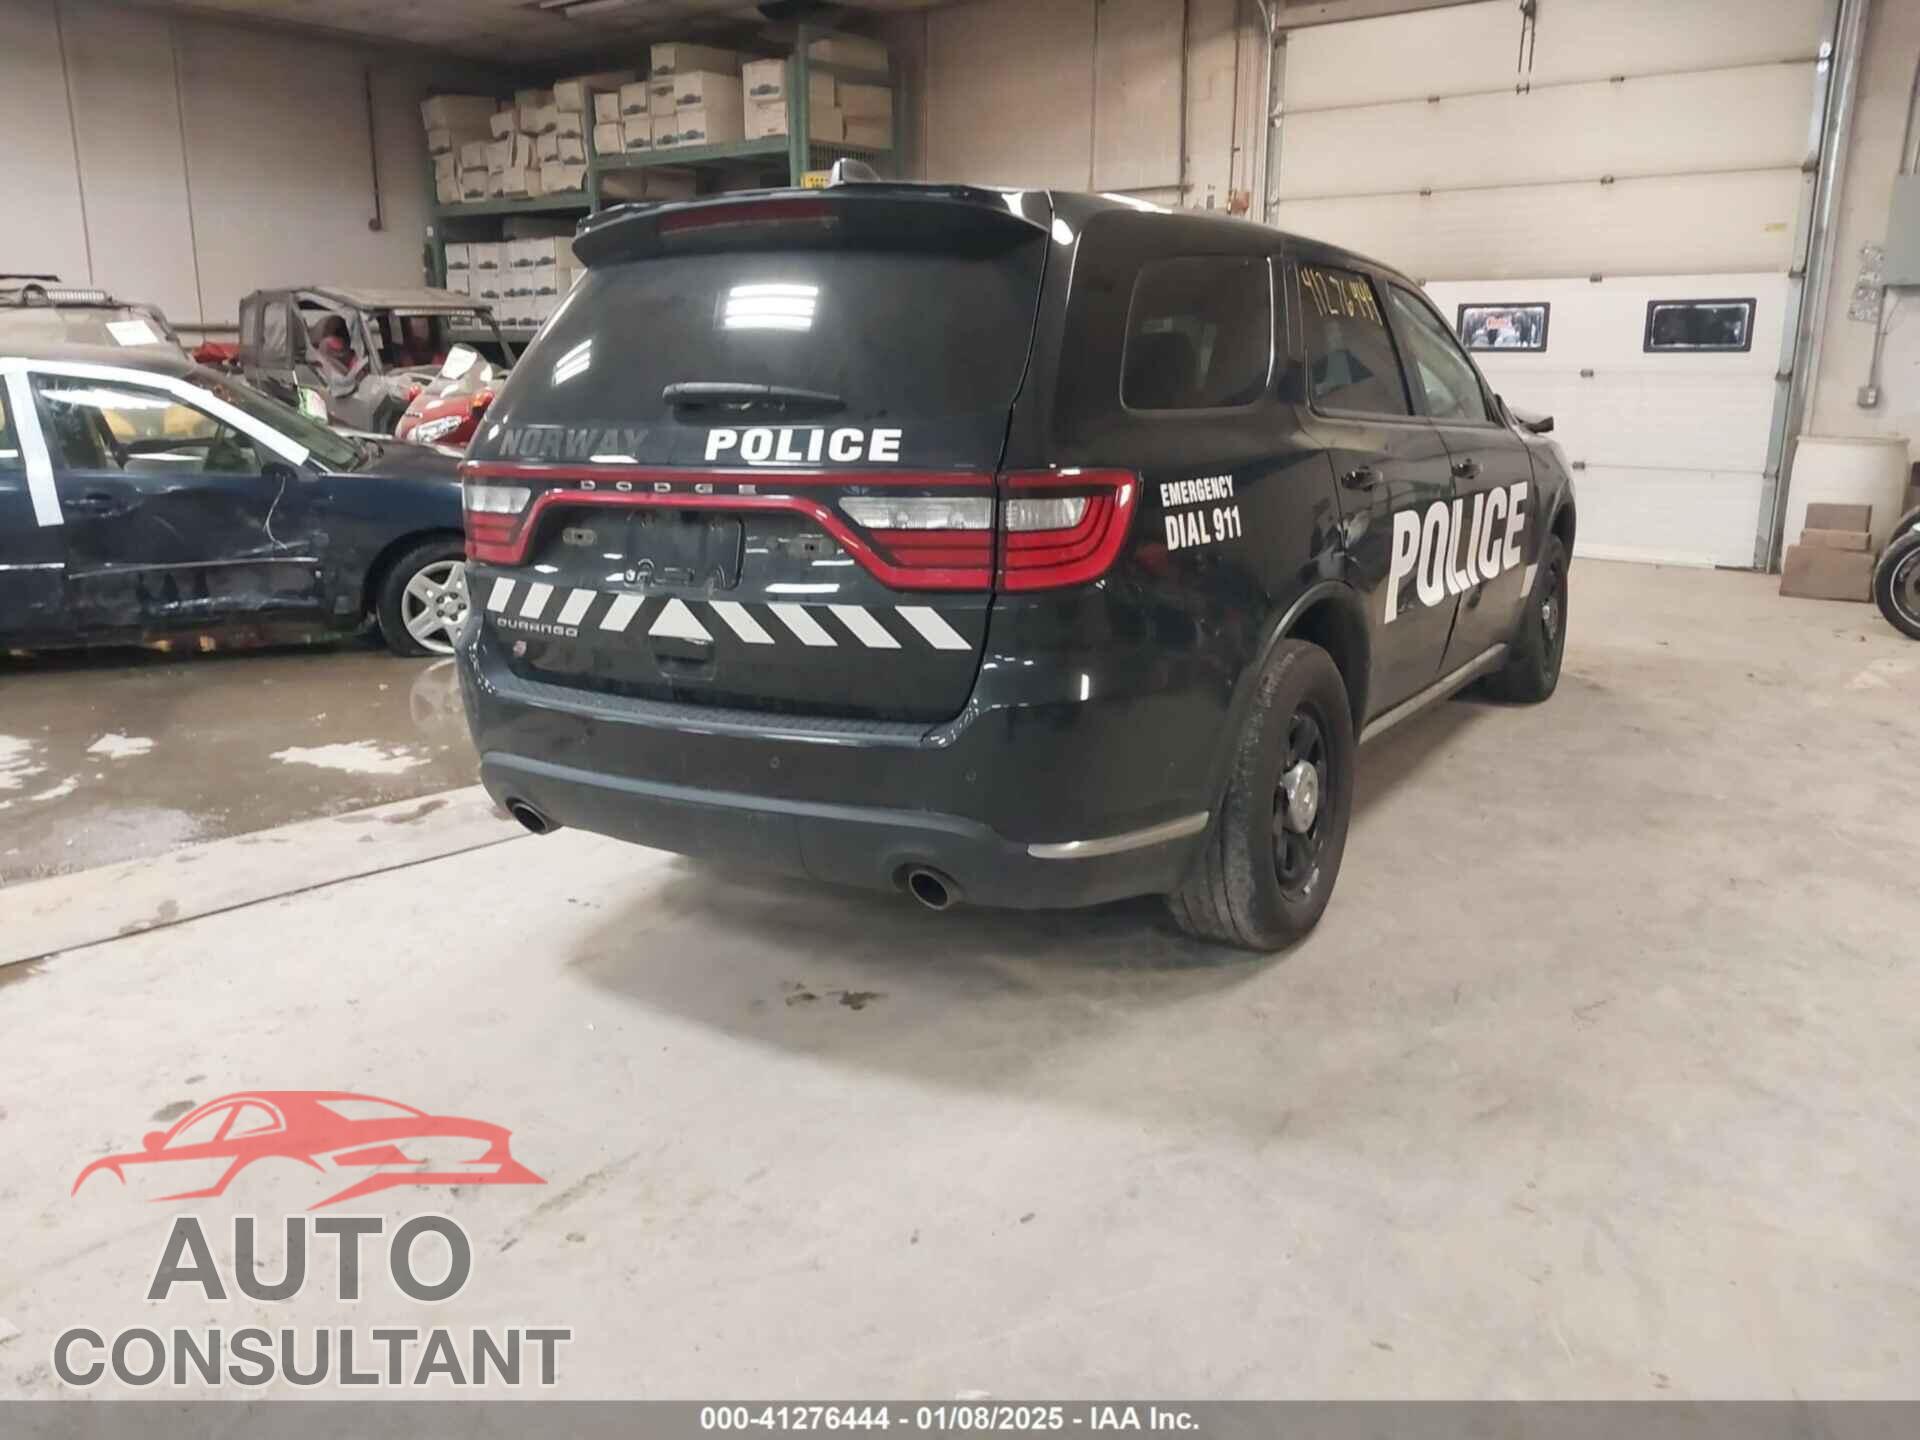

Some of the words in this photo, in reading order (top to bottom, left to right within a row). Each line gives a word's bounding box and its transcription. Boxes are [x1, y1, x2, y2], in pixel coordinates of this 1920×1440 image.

[499, 427, 649, 458] NORWAY
[704, 428, 903, 463] POLICE
[579, 479, 757, 496] DODGE
[1160, 474, 1234, 508] EMERGENCY
[1164, 510, 1211, 551] DIAL
[1212, 504, 1242, 542] 911
[1384, 480, 1529, 624] POLICE
[496, 617, 579, 638] DURANGO
